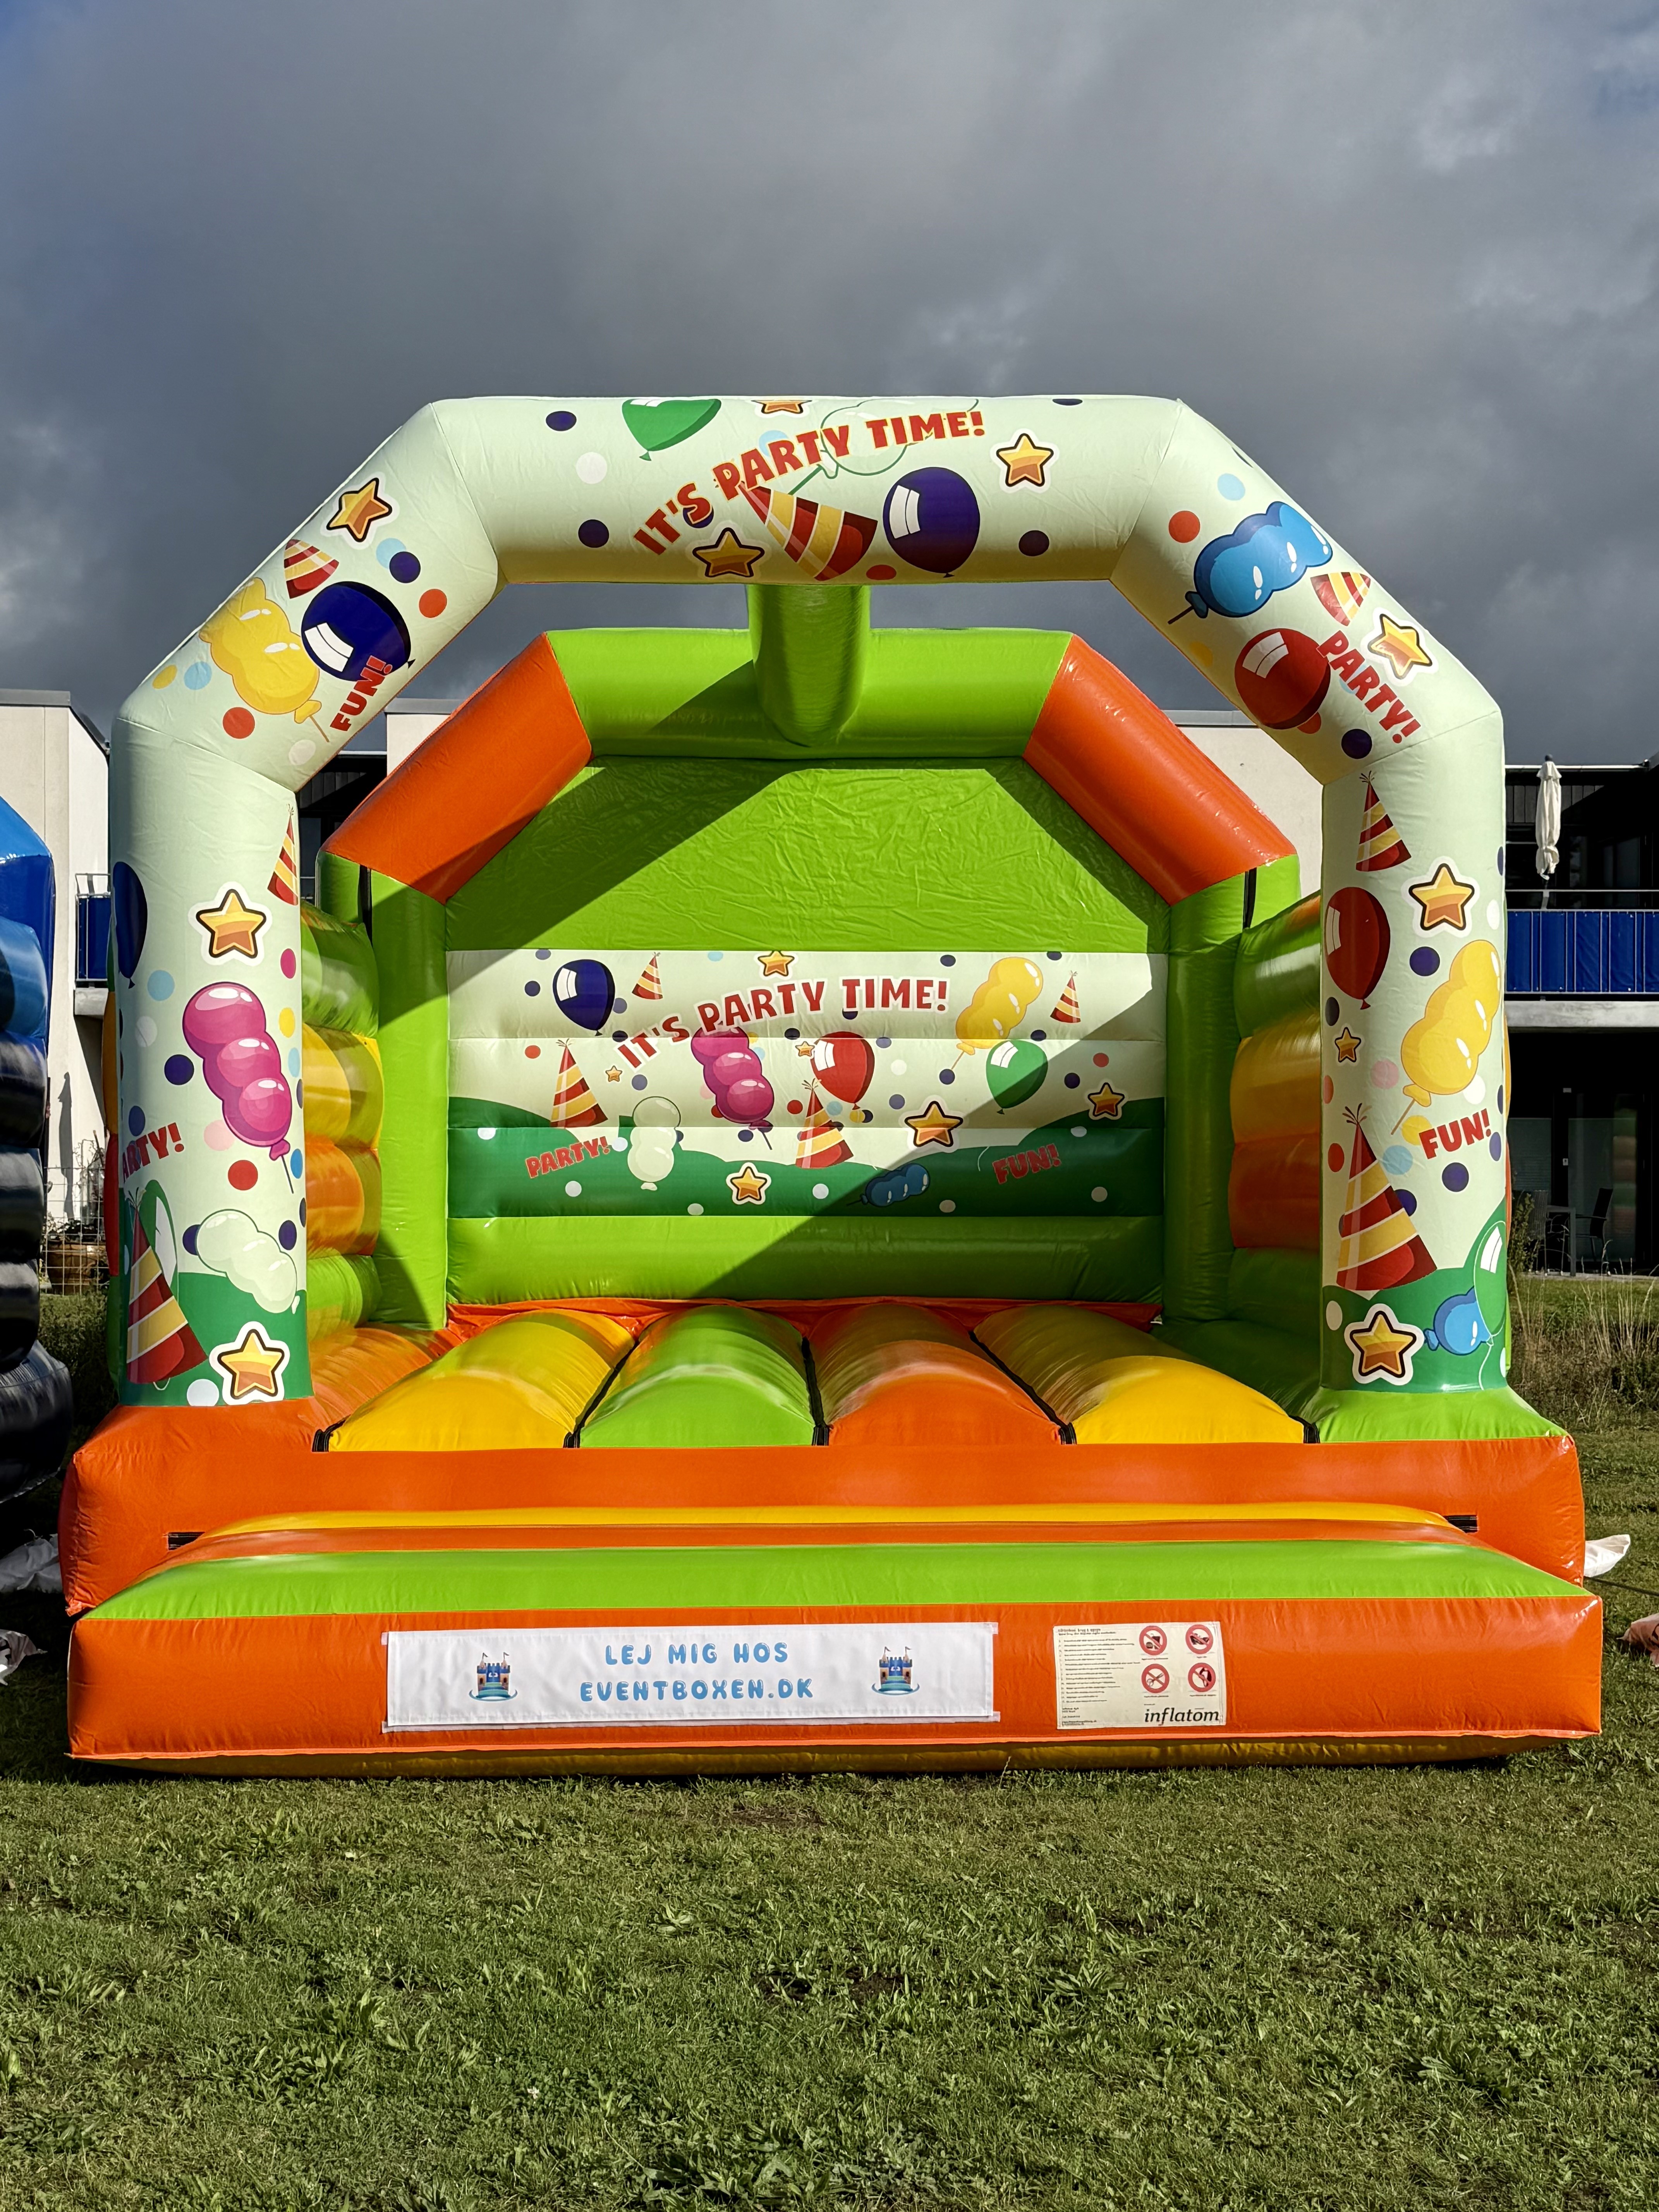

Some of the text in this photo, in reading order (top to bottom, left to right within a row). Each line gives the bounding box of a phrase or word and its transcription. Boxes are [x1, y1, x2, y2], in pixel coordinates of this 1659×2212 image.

[634, 411, 986, 555] IT'S PARTY TIME!
[330, 655, 393, 731] FUN!
[1317, 630, 1421, 744] PARTY!
[619, 979, 947, 1068] IT'S PARTY TIME!
[123, 1122, 184, 1183] ARTY!
[526, 1136, 610, 1178] PARTY!
[1419, 1108, 1491, 1159] FUN!
[992, 1143, 1061, 1184] FUN!
[605, 1642, 788, 1665] LEJ MIG HOS
[580, 1678, 813, 1702] EVENTBOXEN.DK
[1145, 1707, 1219, 1726] inflatom
